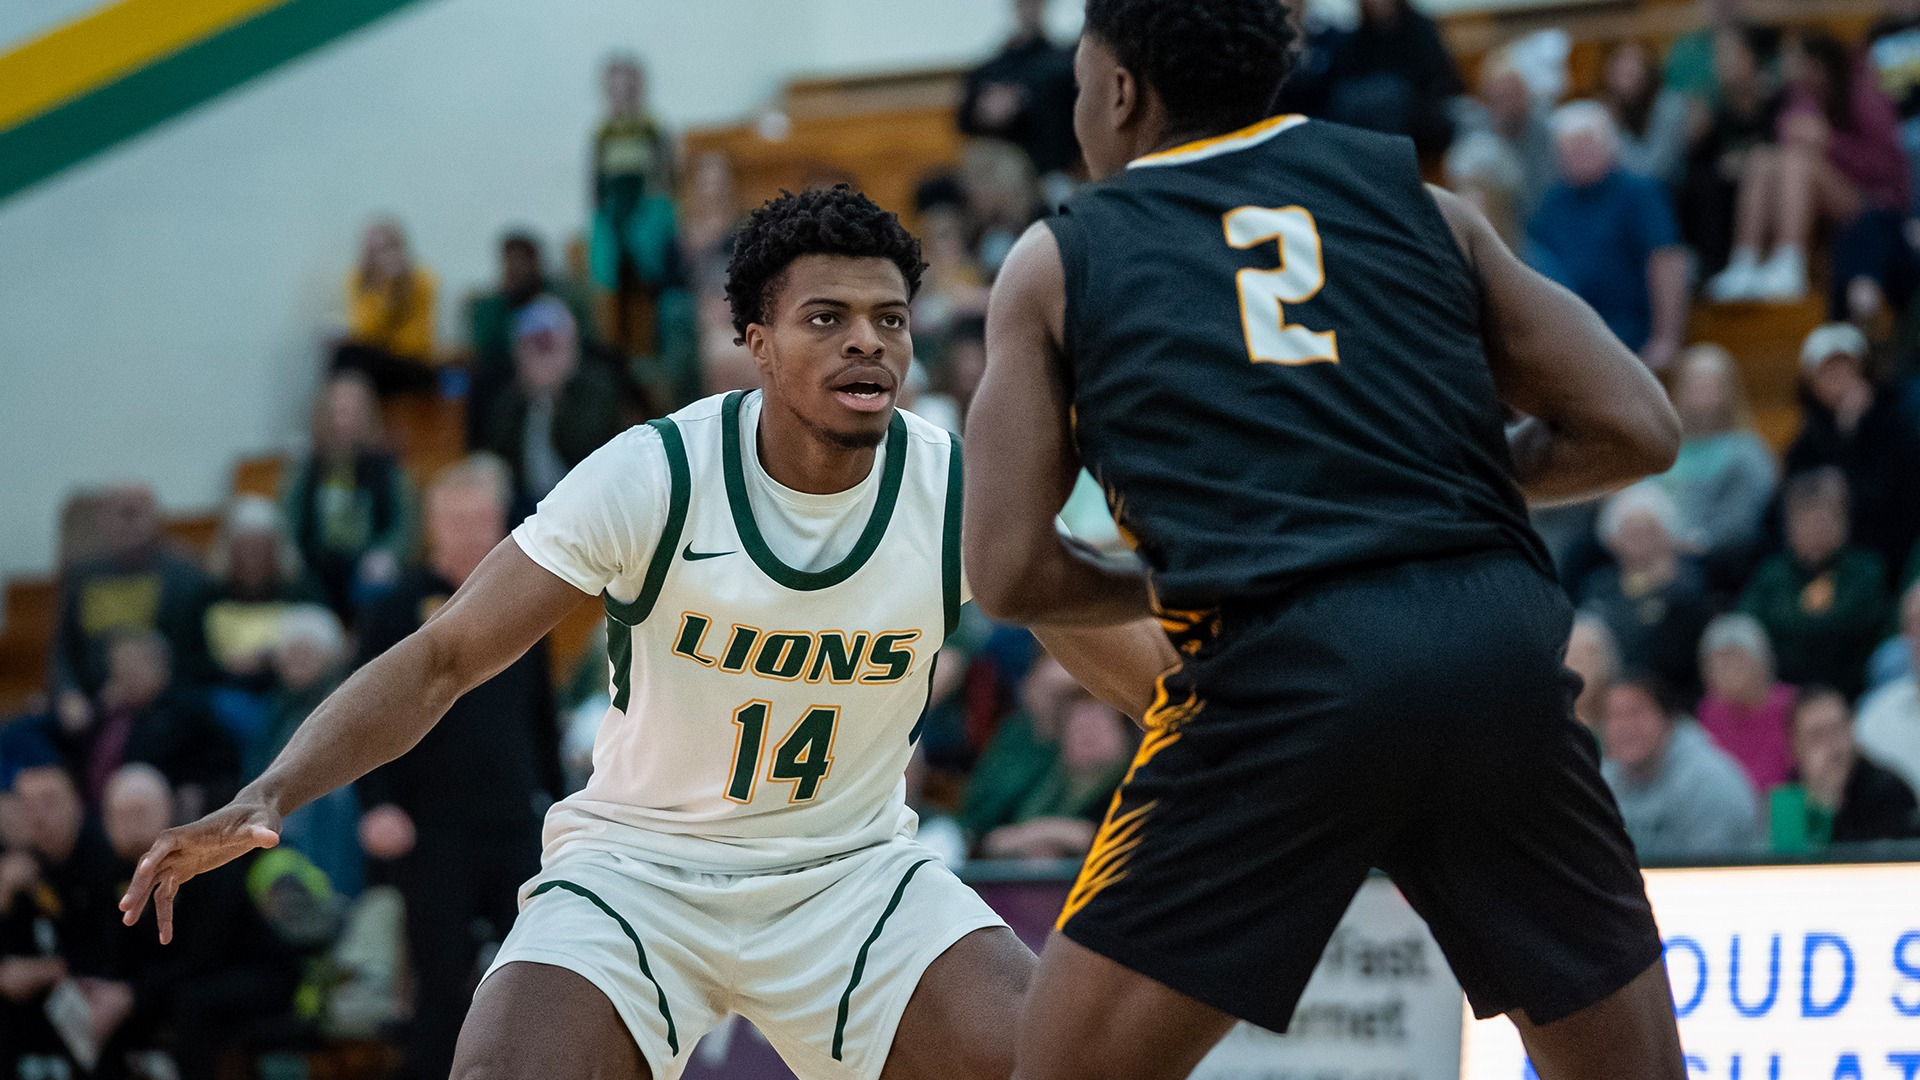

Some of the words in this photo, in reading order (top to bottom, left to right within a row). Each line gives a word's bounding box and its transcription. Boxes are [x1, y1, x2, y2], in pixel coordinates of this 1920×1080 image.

[1222, 205, 1339, 365] 2
[671, 610, 922, 685] LIONS
[723, 698, 841, 805] 14
